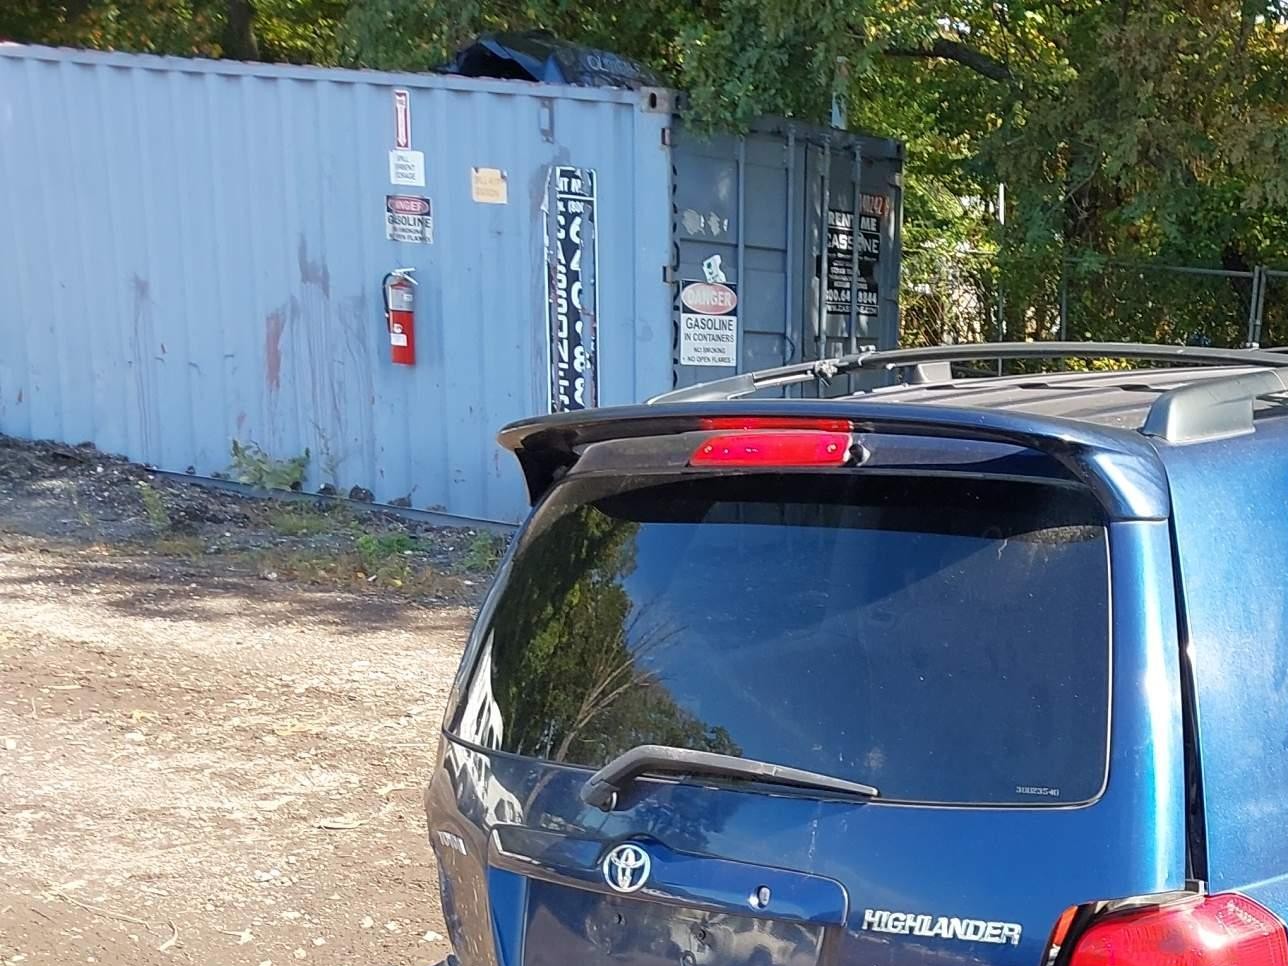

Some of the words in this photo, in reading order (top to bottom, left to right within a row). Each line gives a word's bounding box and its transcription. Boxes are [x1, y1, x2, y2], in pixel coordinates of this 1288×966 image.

[861, 216, 877, 231] ME
[687, 288, 733, 307] DANGER
[686, 317, 734, 332] GASOLINE
[684, 332, 692, 341] IN
[693, 333, 734, 343] CONTAINERS
[862, 909, 1022, 946] HIGHLANDER
